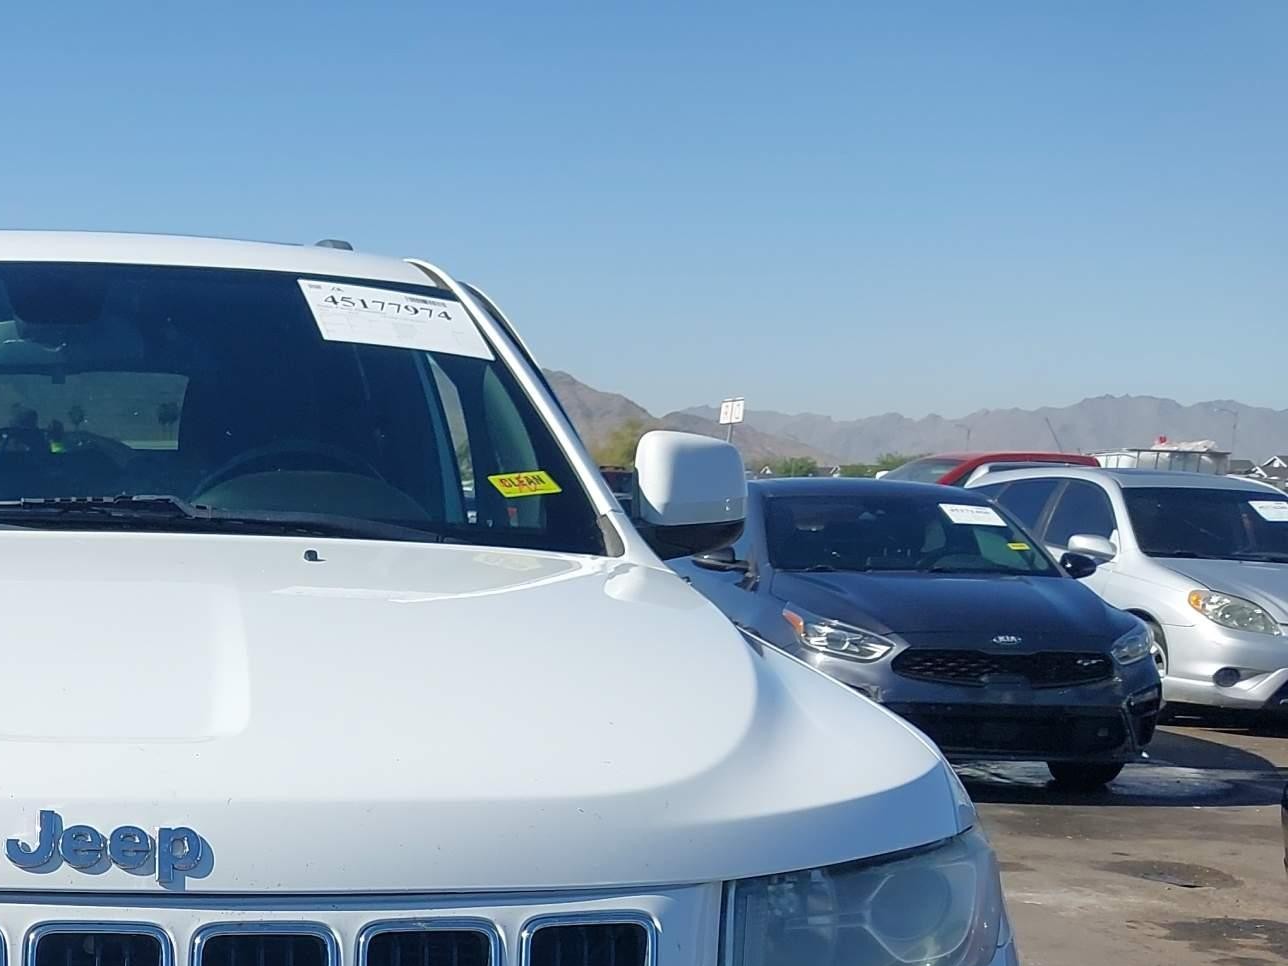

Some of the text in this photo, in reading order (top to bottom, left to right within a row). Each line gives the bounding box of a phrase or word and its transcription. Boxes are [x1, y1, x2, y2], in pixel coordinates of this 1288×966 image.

[324, 294, 452, 321] 45177974
[499, 475, 546, 488] CLEAN
[5, 808, 204, 884] Jeep
